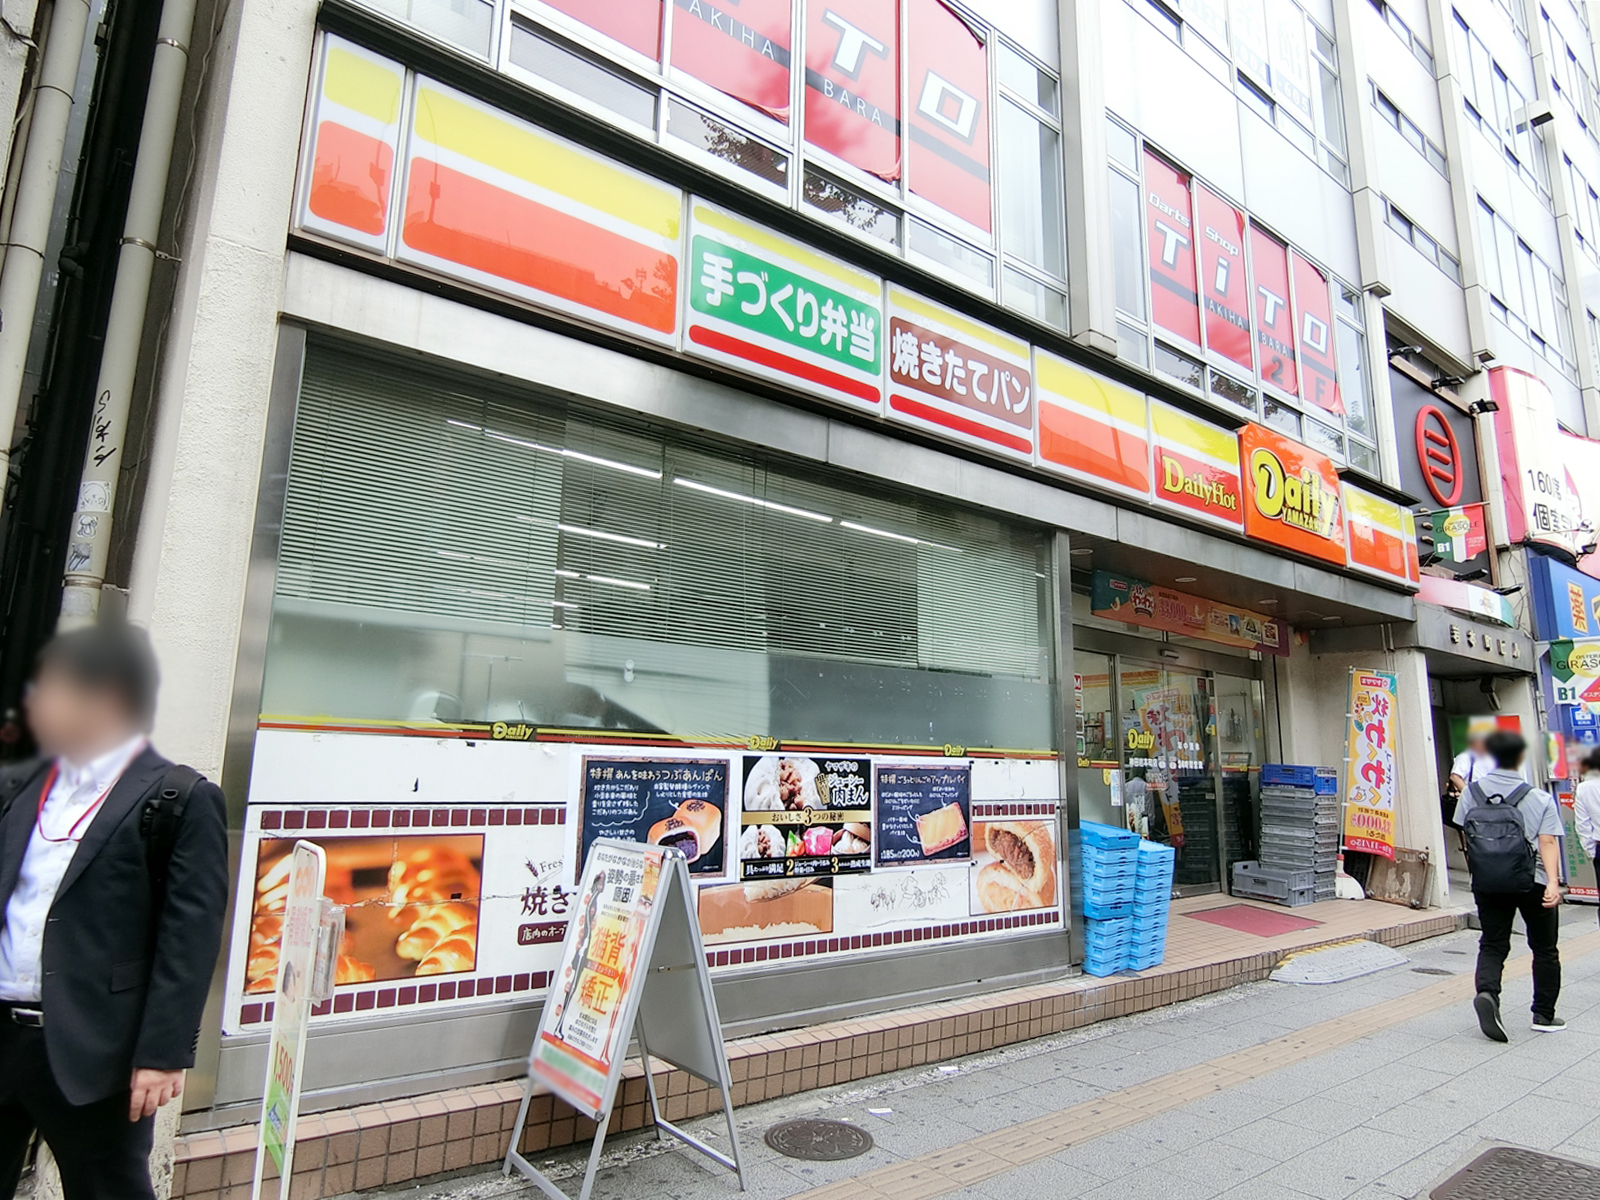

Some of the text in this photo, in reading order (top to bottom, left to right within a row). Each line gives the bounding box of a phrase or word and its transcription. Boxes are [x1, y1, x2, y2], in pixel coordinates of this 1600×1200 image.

[824, 78, 882, 126] BARA
[1149, 192, 1239, 257] Darts Shop
[701, 252, 876, 363] 手づくり弁当
[1208, 299, 1288, 357] AKIHA BARA
[891, 327, 1030, 414] 焼きたてパン
[1251, 447, 1339, 539] Daily
[1437, 541, 1451, 553] B1
[1556, 658, 1600, 671] GIRAS
[1557, 686, 1576, 701] B1
[492, 721, 534, 740] Daily
[750, 734, 778, 750] Daily
[1127, 728, 1155, 749] Daily
[944, 743, 965, 757] Daily
[832, 784, 869, 807] 肉まん
[521, 886, 571, 916] 焼き
[590, 926, 627, 966] 猫背
[577, 974, 614, 1016] 矯正
